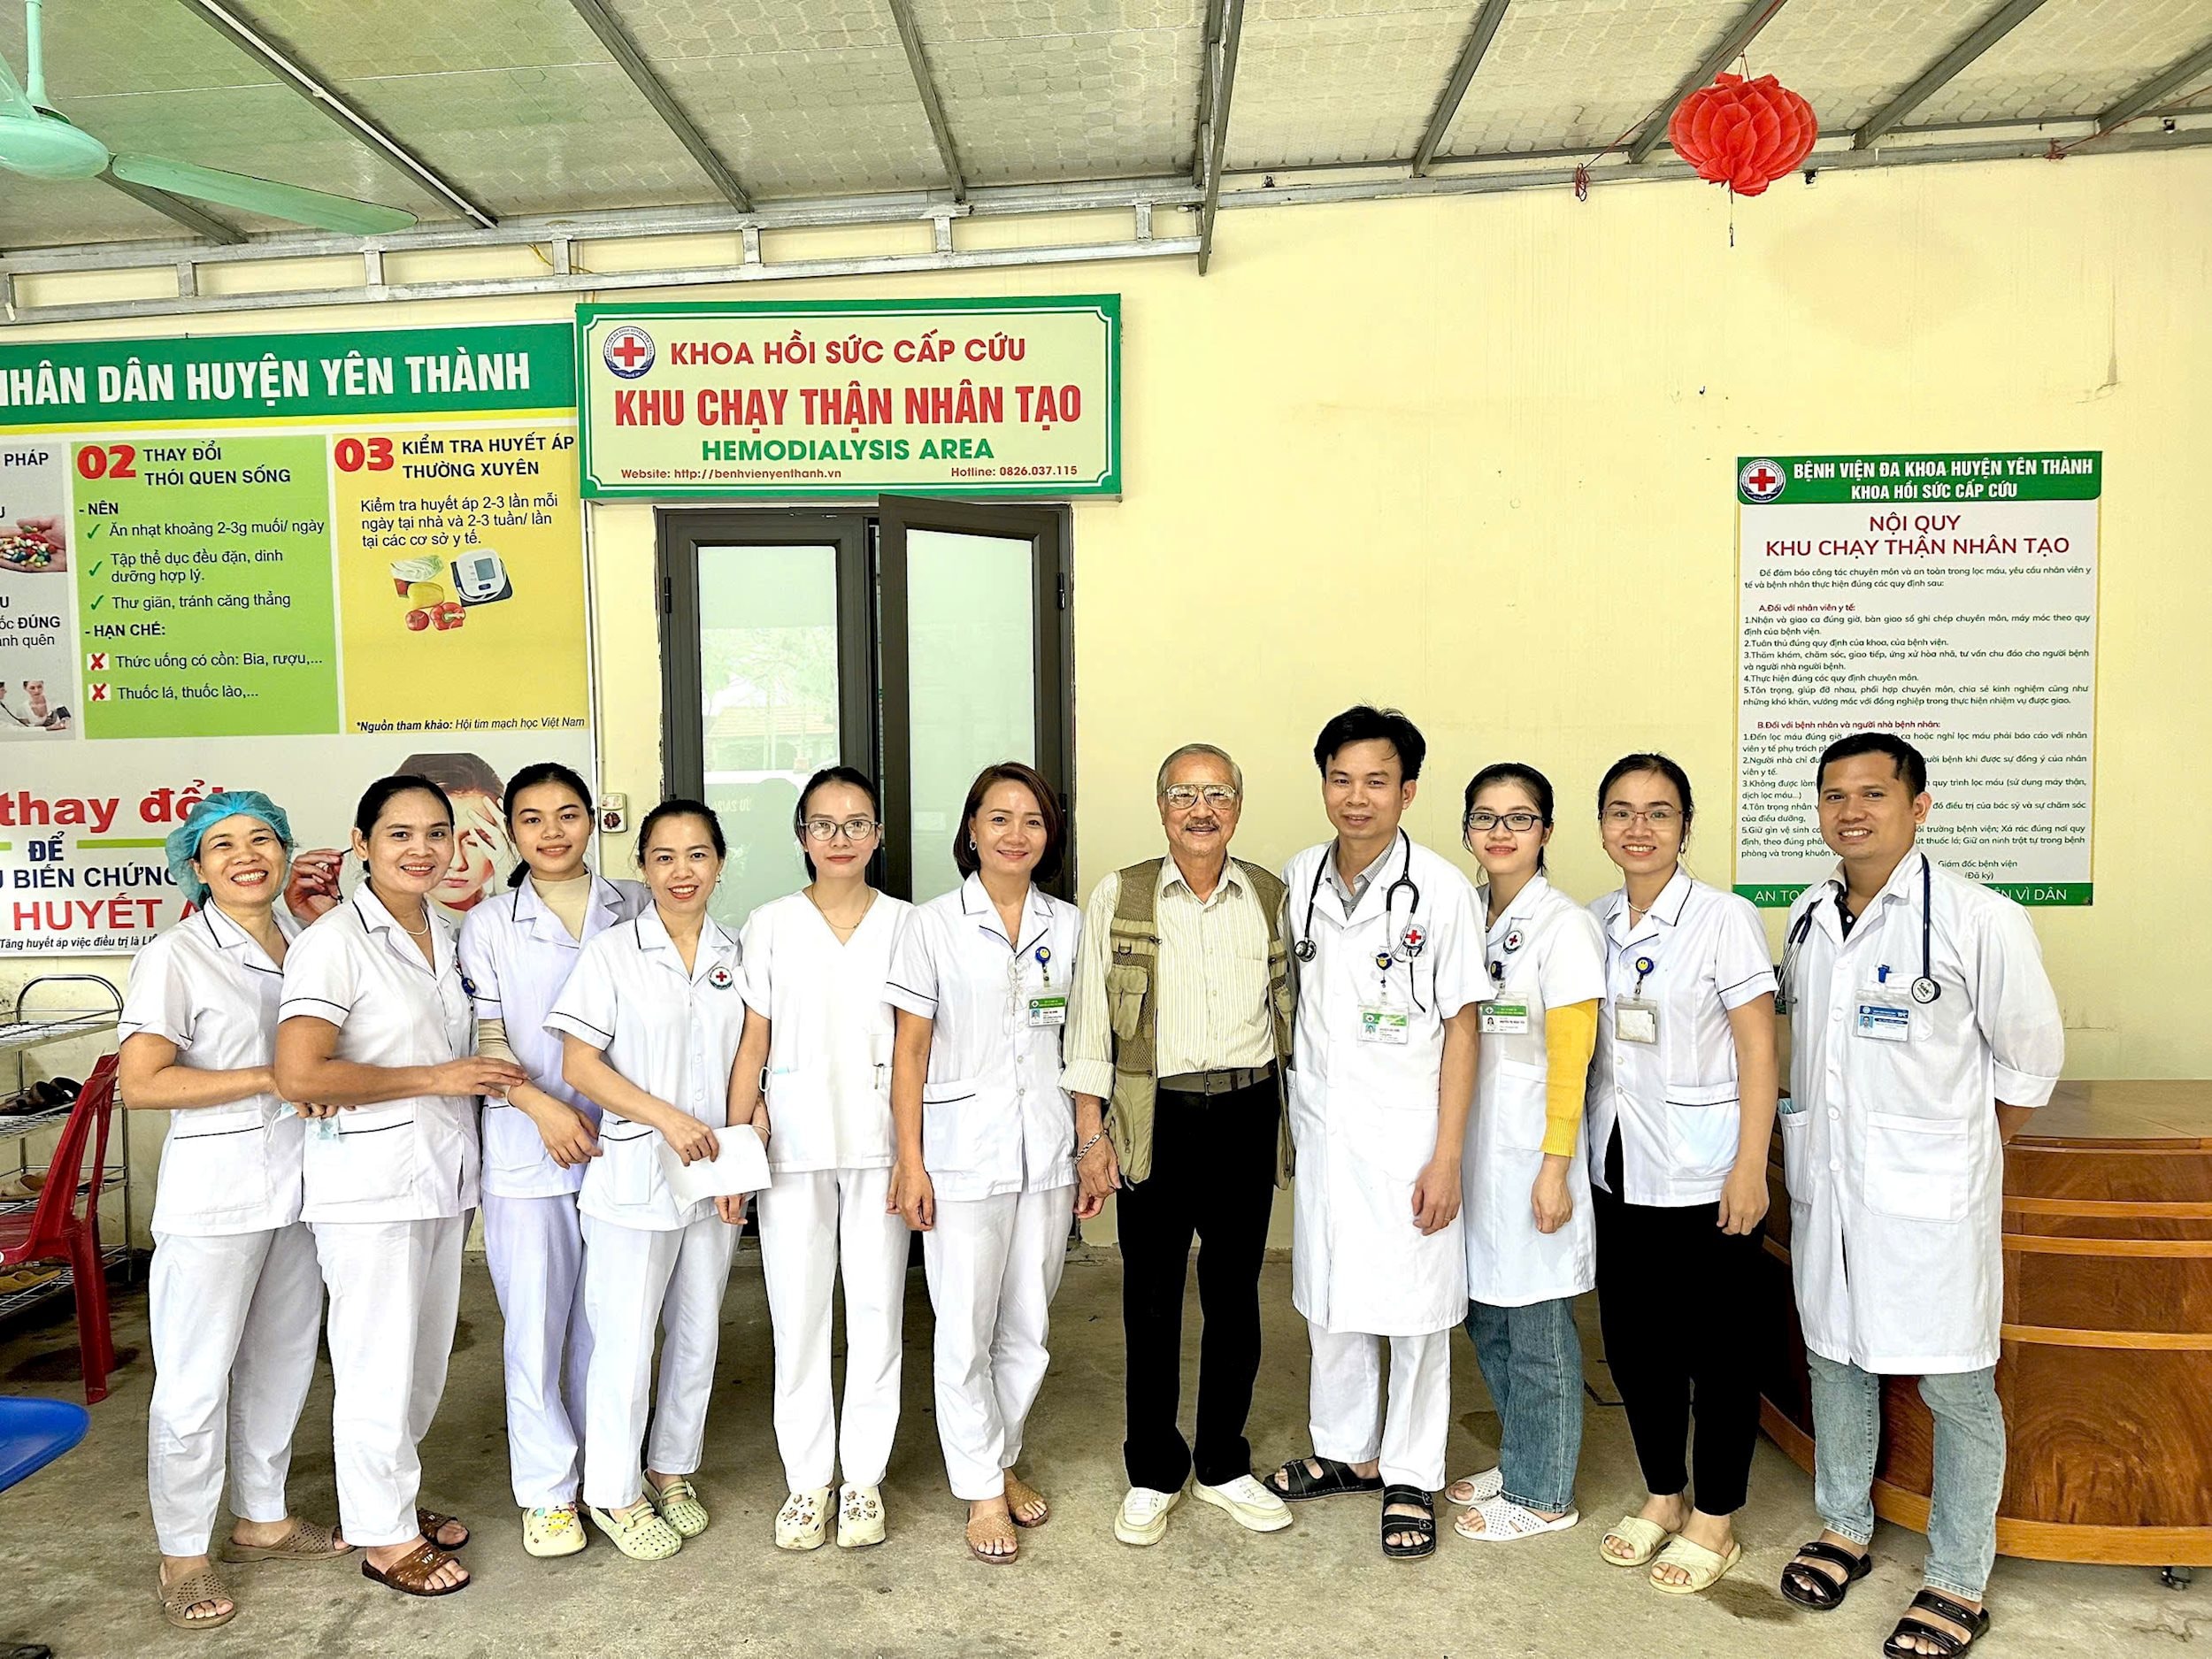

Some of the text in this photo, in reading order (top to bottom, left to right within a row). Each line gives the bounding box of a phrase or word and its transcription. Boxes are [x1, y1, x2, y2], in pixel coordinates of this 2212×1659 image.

[671, 342, 753, 365] KHOA
[764, 329, 815, 365] HỒI
[825, 334, 883, 364] SỨC
[893, 328, 955, 363] CẤP
[964, 332, 1025, 362] CỨU
[96, 357, 174, 403] DÂN
[186, 352, 309, 407] HUYỆN
[319, 349, 394, 396] YÊN
[403, 346, 530, 393] THÀNH
[614, 378, 1082, 434] KHU CHẠY THẬN NHÂN TẠO
[142, 440, 222, 462] THAY ĐỔI
[402, 432, 574, 454] KIỂM TRA HUYẾT ÁP
[702, 438, 995, 461] HEMODIALYSIS AREA
[4, 452, 49, 466] PHÁP
[77, 444, 136, 479] 02
[334, 436, 394, 472] 03
[143, 464, 291, 486] THÓI QUEN SỐNG
[401, 457, 539, 479] THƯỜNG XUYÊN
[620, 468, 841, 480] Website: http://benhvienyenthanh.vn
[950, 465, 1078, 477] Hotline: 0826.037.115
[1793, 460, 1835, 479] BỆNH
[1839, 459, 1875, 478] VIỆN
[1878, 462, 1901, 477] ĐA
[1904, 461, 1947, 477] KHOA
[1950, 460, 2002, 476] HUYỆN
[2006, 459, 2037, 475] YÊN
[2040, 458, 2093, 474] THÀNH
[1850, 479, 2017, 499] KHOA HỒI SỨC CẤP CỨU
[87, 499, 119, 515] NÊN
[360, 492, 558, 513] Kiểm tra huyết áp 2-3 lần mỗi
[108, 517, 325, 538] Ăn nhạt khoảng 2-3g muối/ ngày
[361, 510, 552, 533] ngày tại nhà và 2-3 tuần/ lần
[1869, 512, 1962, 535] NỘI QUY
[361, 534, 379, 549] tại
[381, 534, 406, 546] các
[409, 535, 427, 545] cơ
[430, 531, 449, 544] sở
[464, 528, 481, 543] tế.
[1765, 534, 2070, 559] KHU CHẠY THẬN NHÂN TẠO
[109, 548, 283, 568] Tập thể dục đều đặn, dinh
[111, 568, 205, 584] dưỡng hợp lý.
[111, 593, 291, 611] Thư giãn, tránh căng thẳng
[17, 616, 60, 629] ĐÚNG
[93, 624, 126, 640] HẠN
[21, 633, 55, 649] quên
[115, 652, 322, 670] Thức uống có cồn: Bia, rượu,...
[115, 683, 258, 700] Thuốc lá, thuốc lào,...
[396, 720, 422, 731] tham
[423, 718, 453, 729] khảo:
[454, 718, 472, 731] Hội
[473, 718, 489, 728] tim
[490, 718, 518, 729] mạch
[519, 718, 538, 729] học
[540, 717, 559, 728] Việt
[561, 716, 585, 726] Nam
[0, 790, 120, 833] thay
[27, 831, 65, 862] ĐỂ
[13, 864, 74, 888] BIẾN
[2015, 886, 2067, 900] VÌ DÂN
[12, 892, 164, 931] HUYẾT
[0, 938, 24, 950] Tăng
[26, 936, 54, 949] huyết
[55, 937, 68, 949] áp
[70, 936, 91, 949] việc
[93, 934, 115, 946] điều
[117, 935, 129, 948] trị
[129, 935, 140, 946] là
